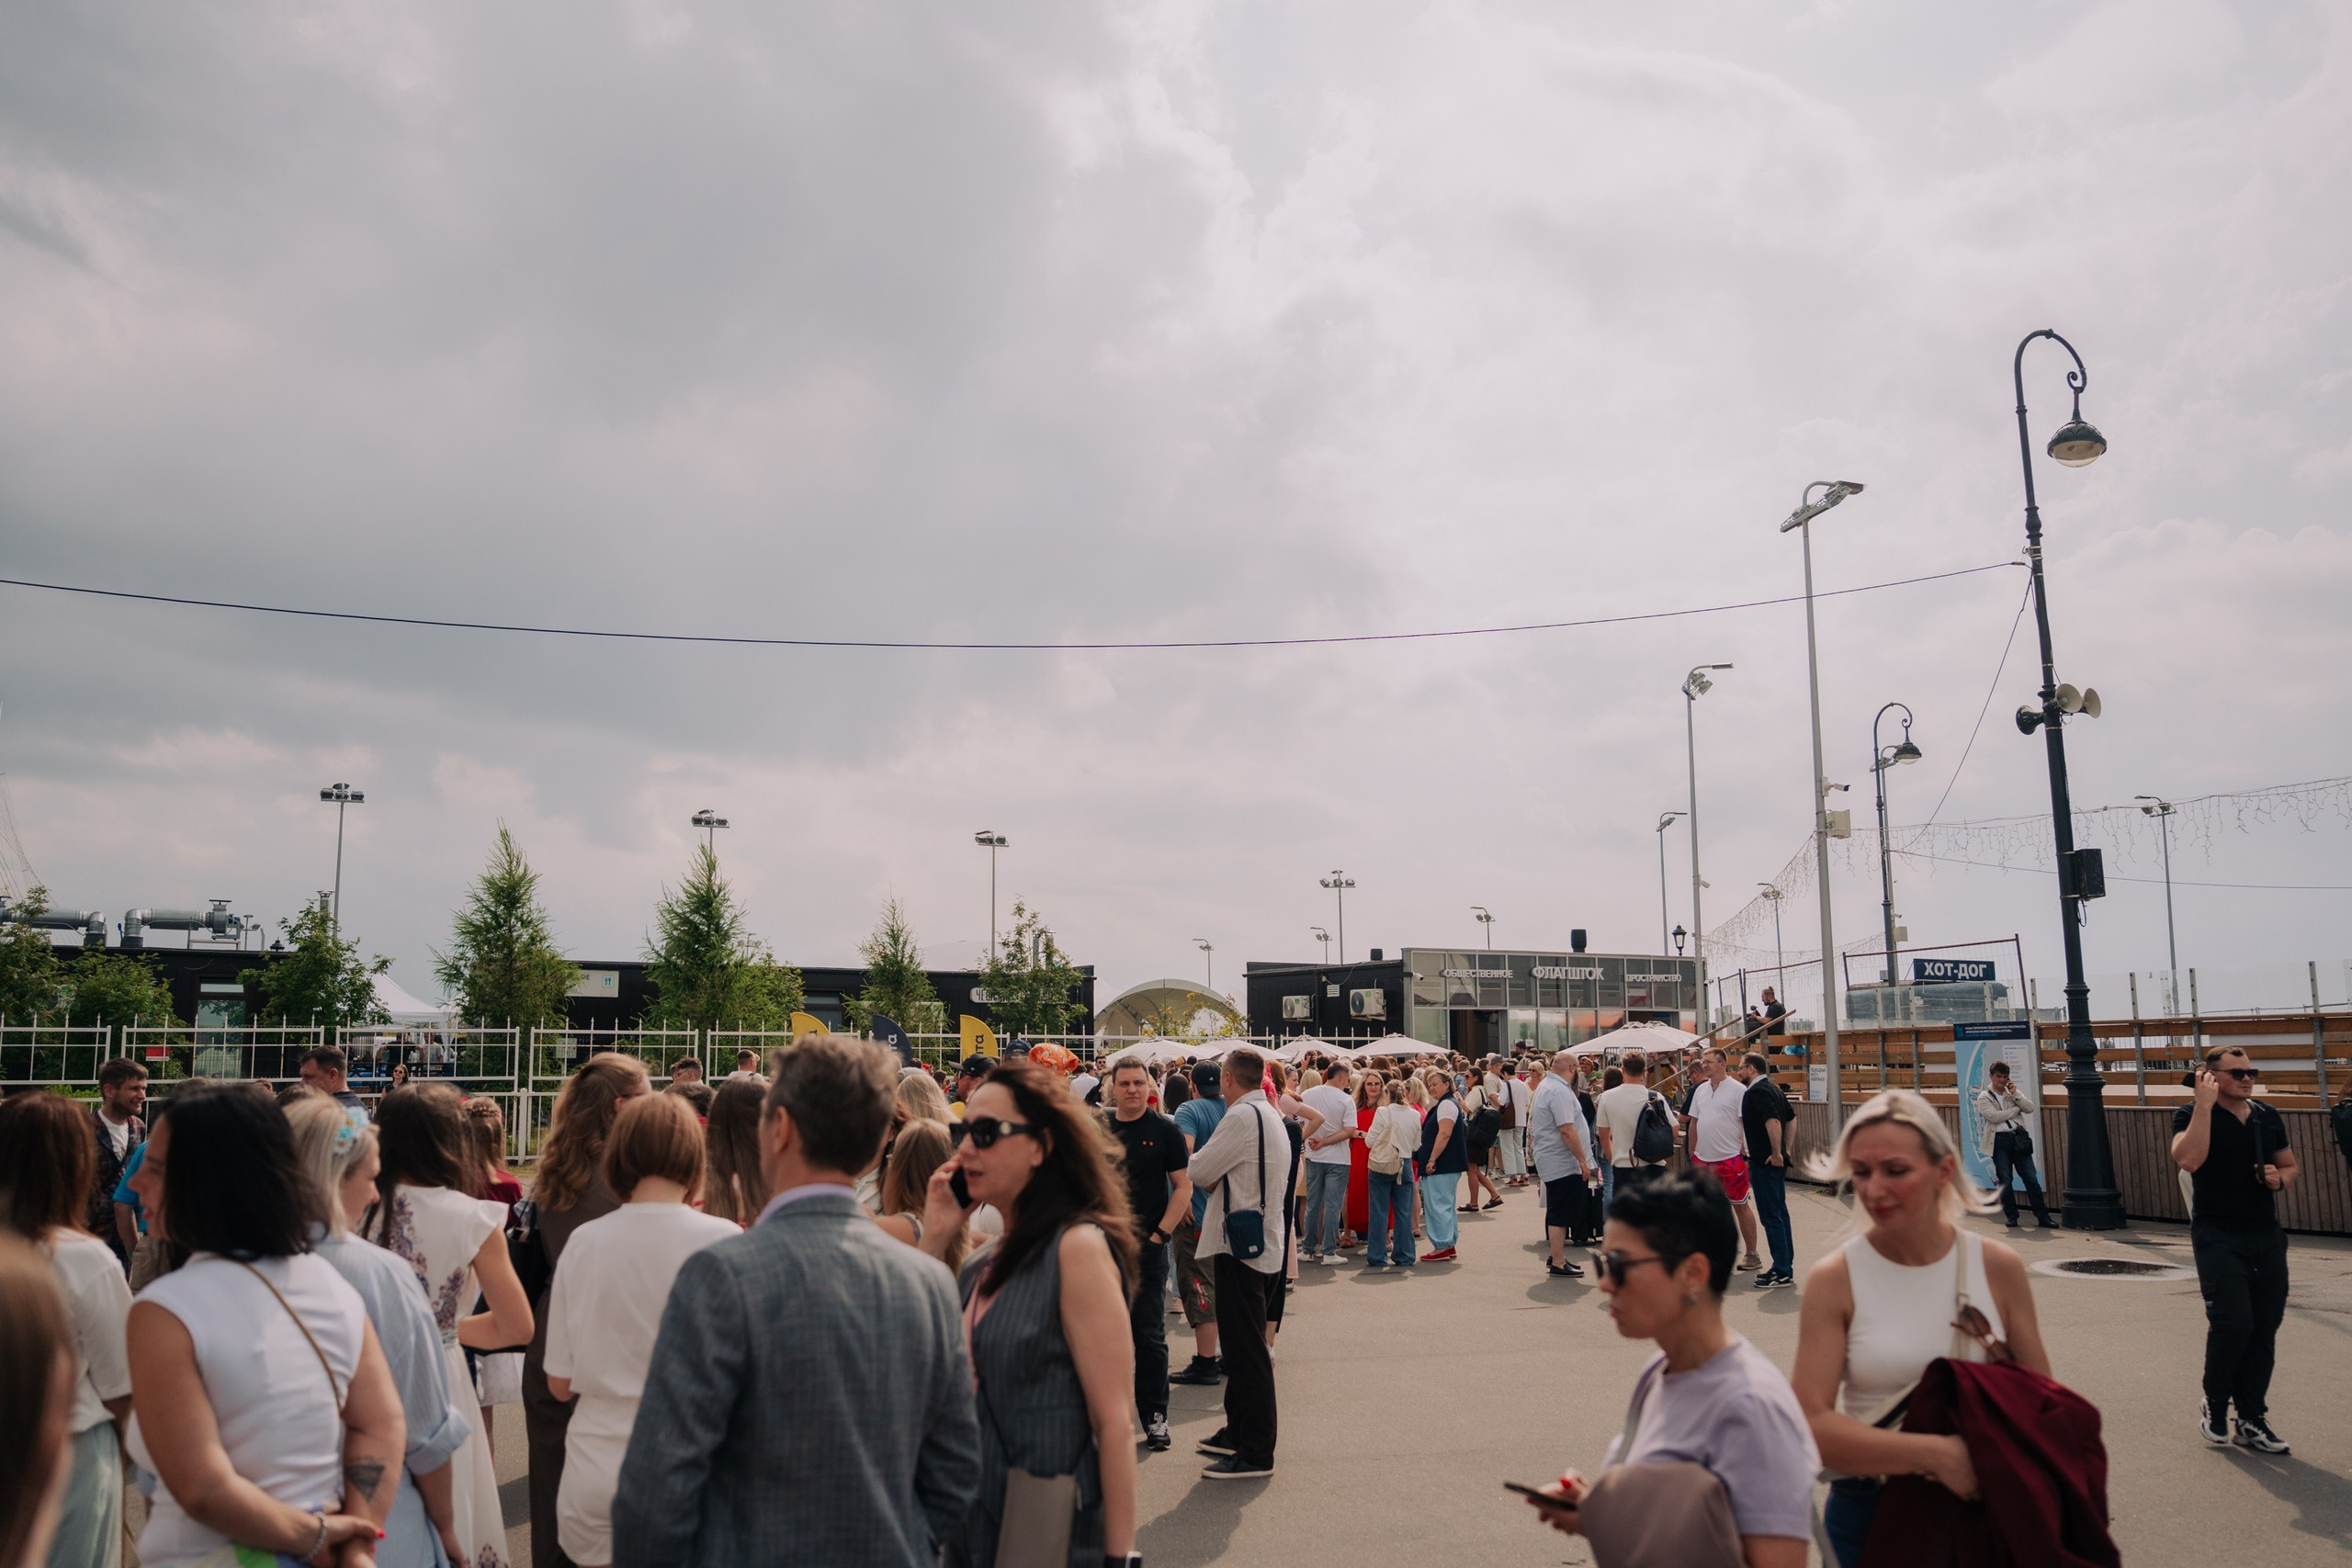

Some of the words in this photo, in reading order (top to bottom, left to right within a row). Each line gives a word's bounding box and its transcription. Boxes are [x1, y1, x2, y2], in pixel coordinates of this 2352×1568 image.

[1443, 968, 1514, 979] ОБЩЕСТВЕННОЕ
[1532, 965, 1605, 981] ФЛАГШТОК
[1624, 974, 1682, 983] ПРОСТРАНСТВО
[1924, 962, 1987, 979] ХОТ-ДОГ
